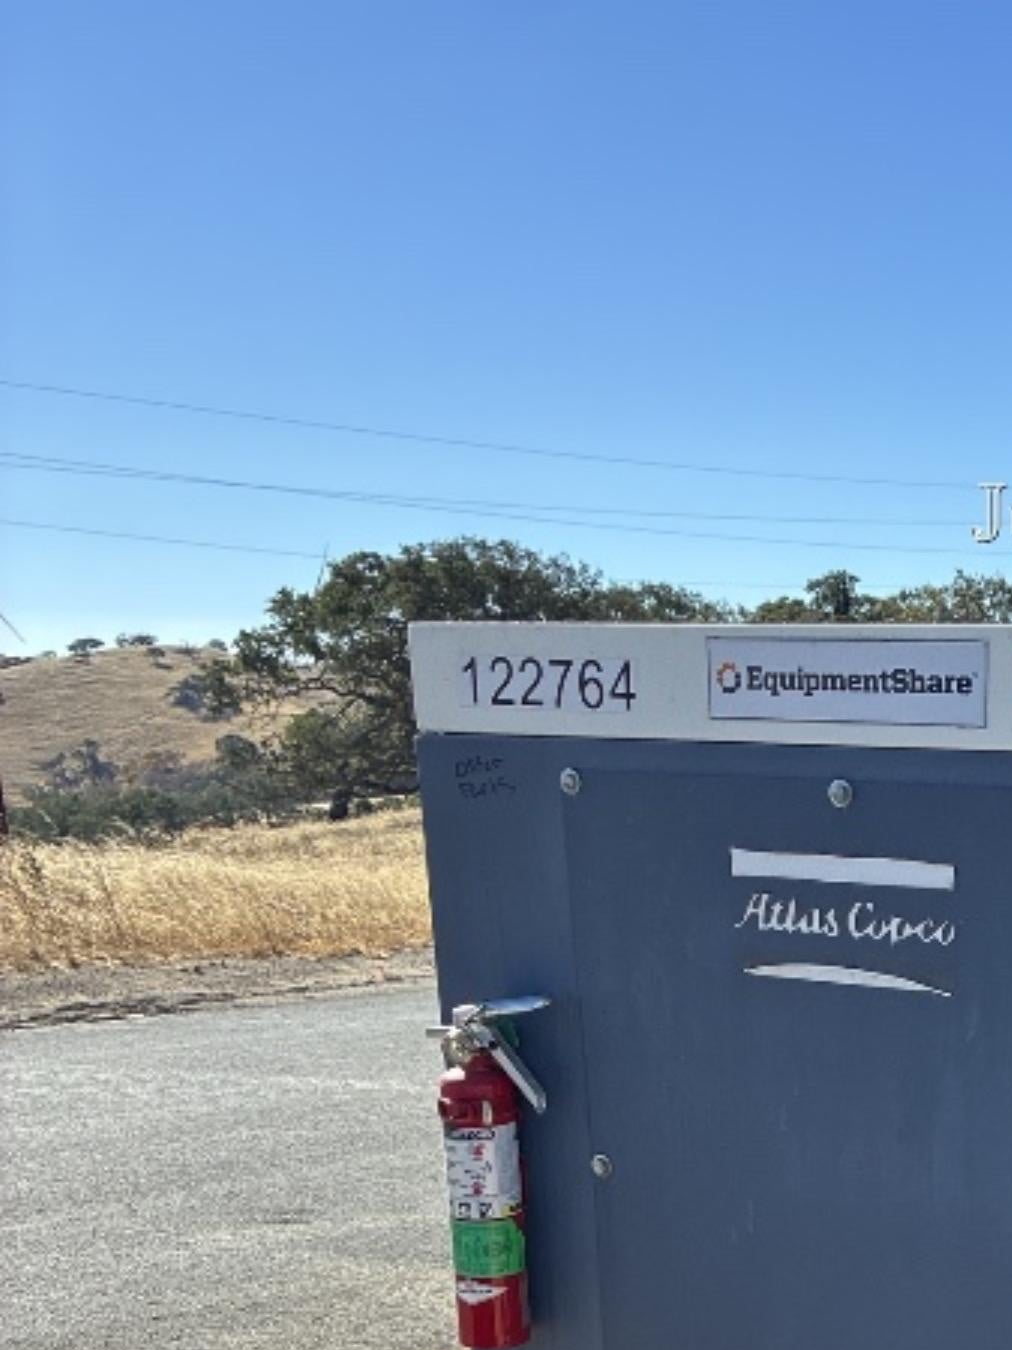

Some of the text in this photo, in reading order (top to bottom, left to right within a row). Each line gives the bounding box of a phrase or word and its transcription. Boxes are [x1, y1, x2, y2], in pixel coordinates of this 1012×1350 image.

[462, 656, 638, 711] 122764
[746, 664, 974, 696] EquipmentShare
[734, 893, 955, 947] Atlas Copco
